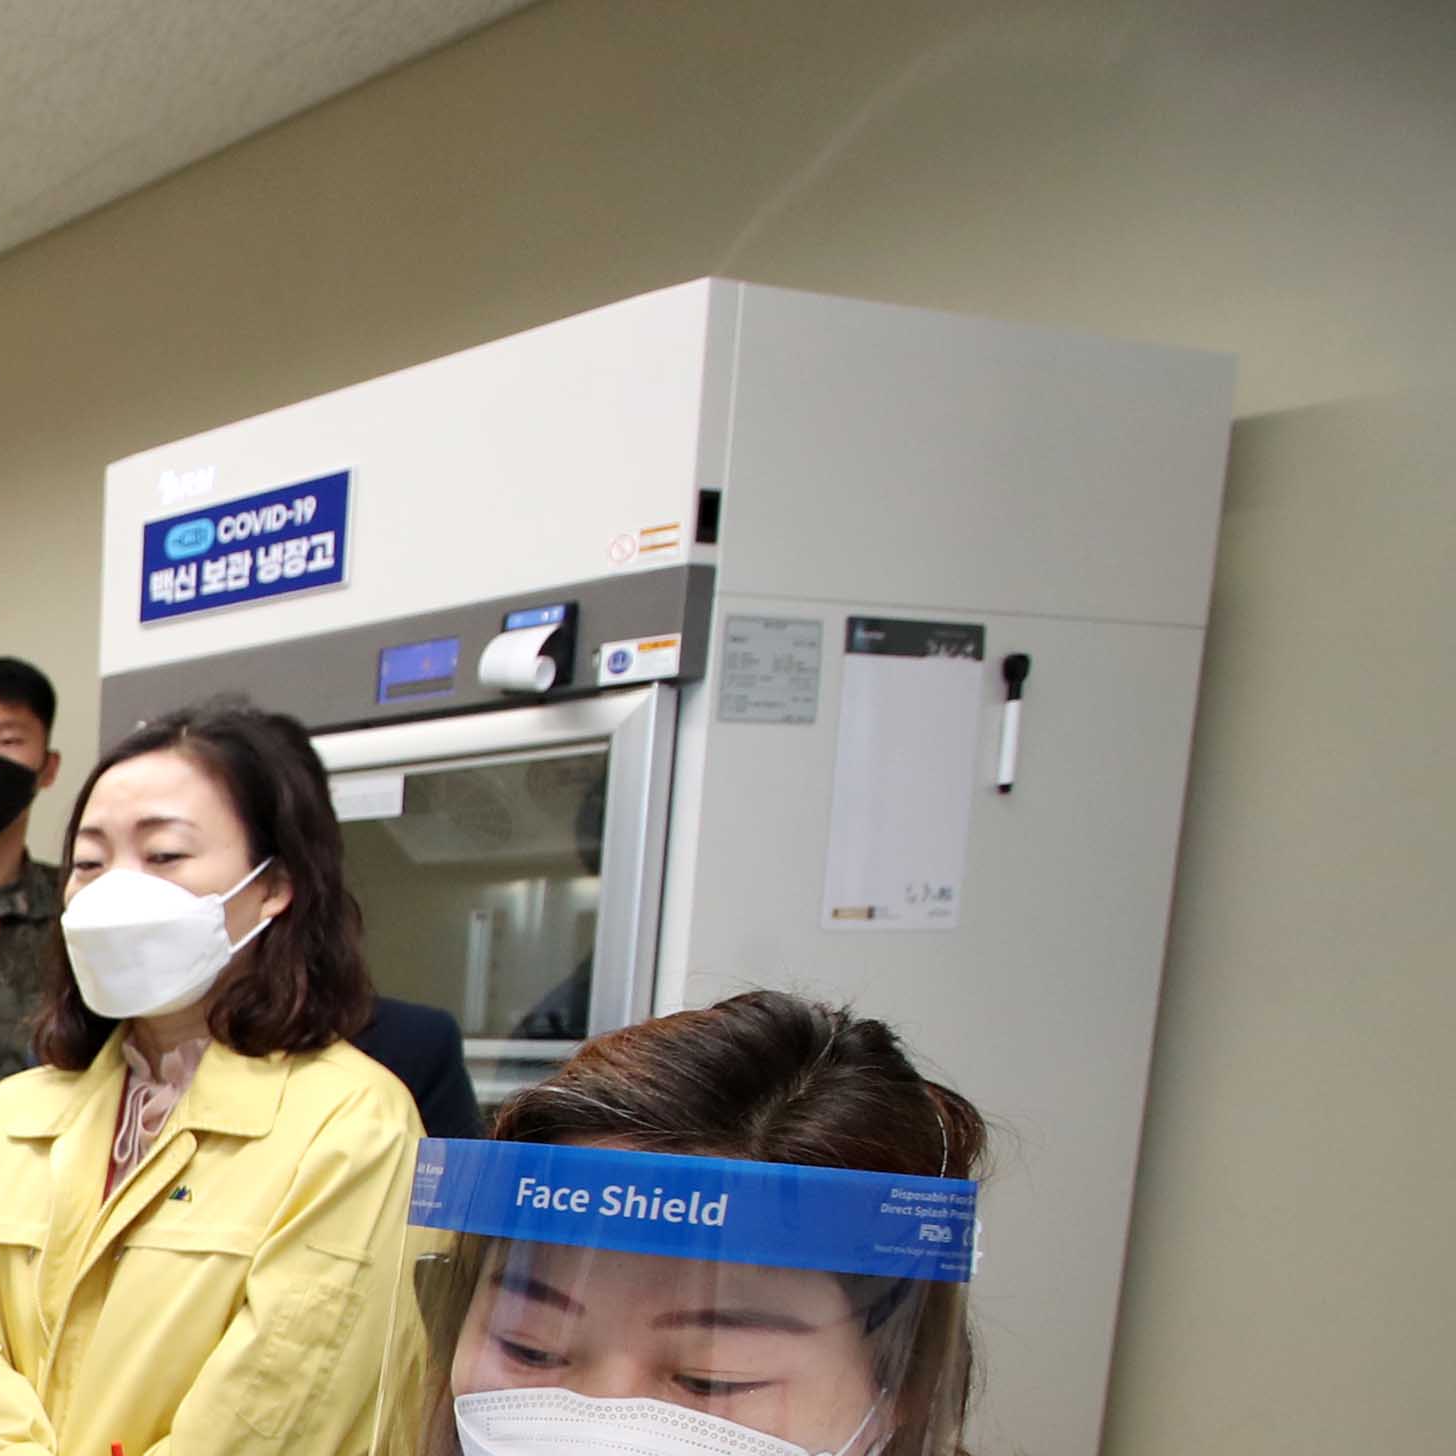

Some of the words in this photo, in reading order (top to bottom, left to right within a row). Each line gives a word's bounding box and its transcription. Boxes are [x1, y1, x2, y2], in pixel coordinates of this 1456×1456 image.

[217, 495, 318, 545] COVID-19
[200, 549, 253, 596] 보관
[256, 530, 336, 585] 냉장고
[515, 1176, 591, 1214] Face
[598, 1184, 729, 1228] Shield
[879, 1202, 913, 1216] Direct
